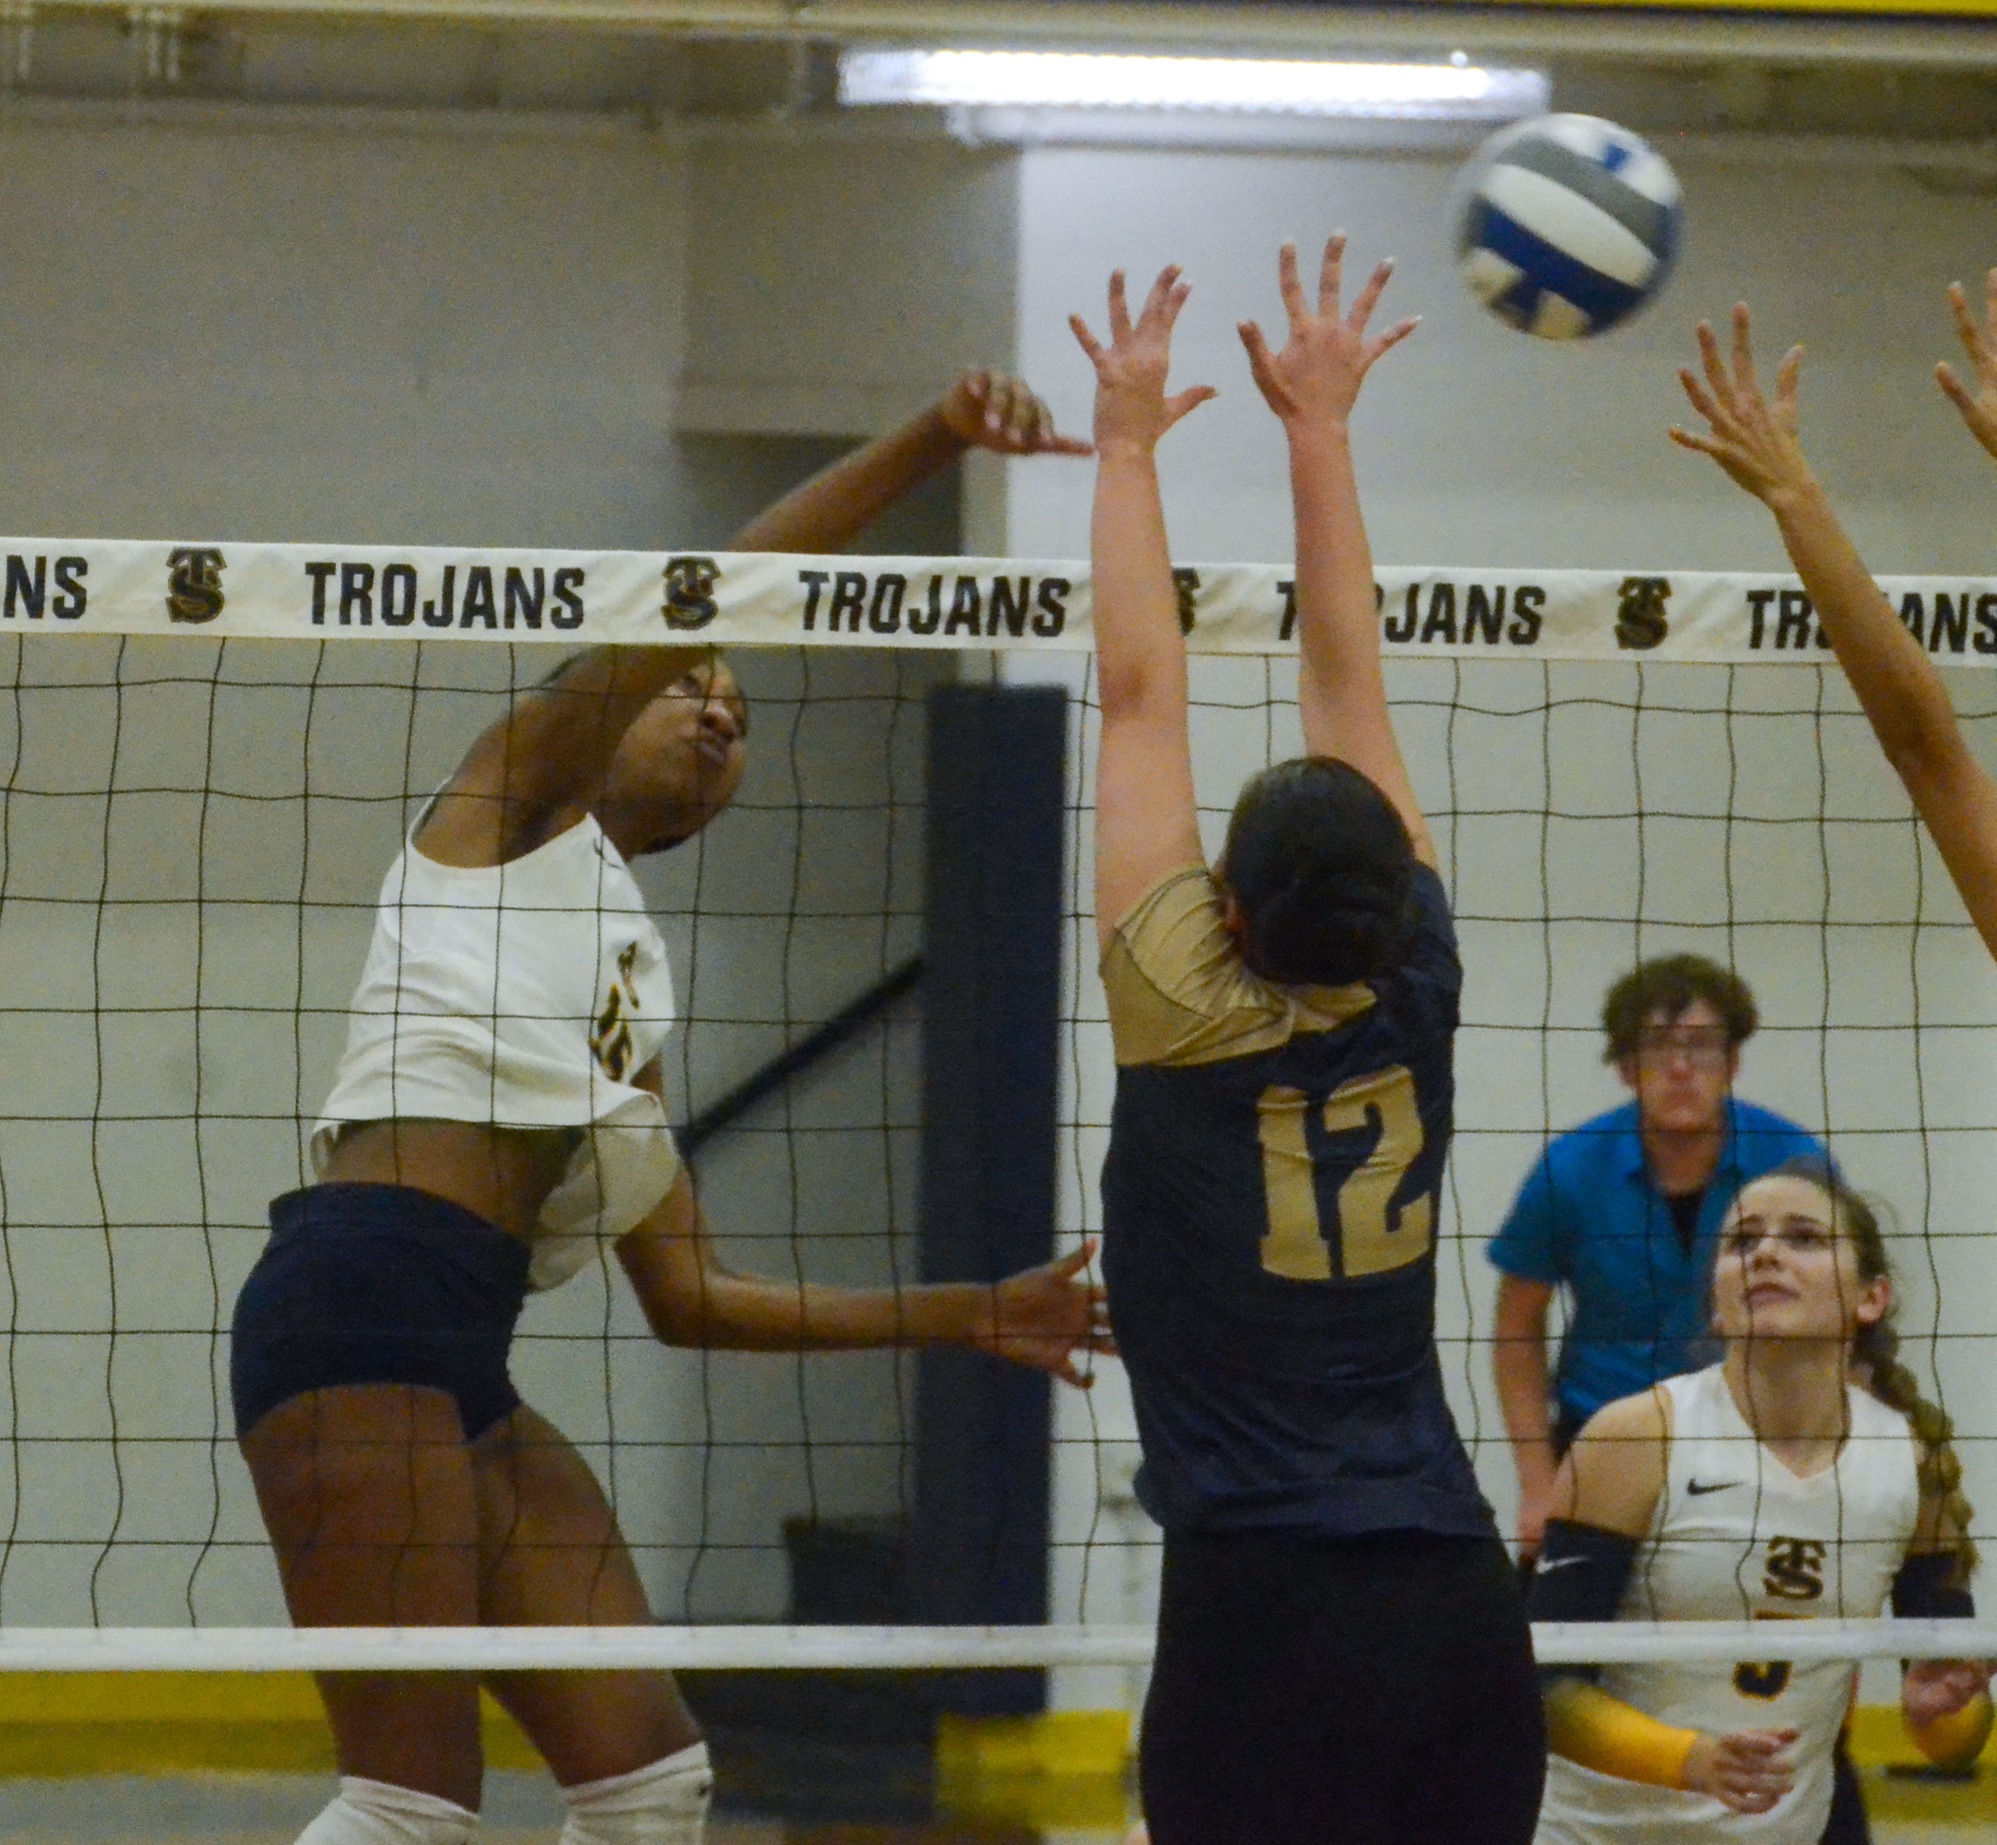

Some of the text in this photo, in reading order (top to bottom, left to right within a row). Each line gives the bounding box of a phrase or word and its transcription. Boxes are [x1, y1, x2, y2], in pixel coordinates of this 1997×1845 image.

[304, 562, 585, 630] TROJANS
[799, 570, 1070, 639] TROJANS
[1276, 581, 1546, 645] TJANS
[1747, 589, 1997, 653] TRANS
[1256, 1064, 1431, 1280] 12
